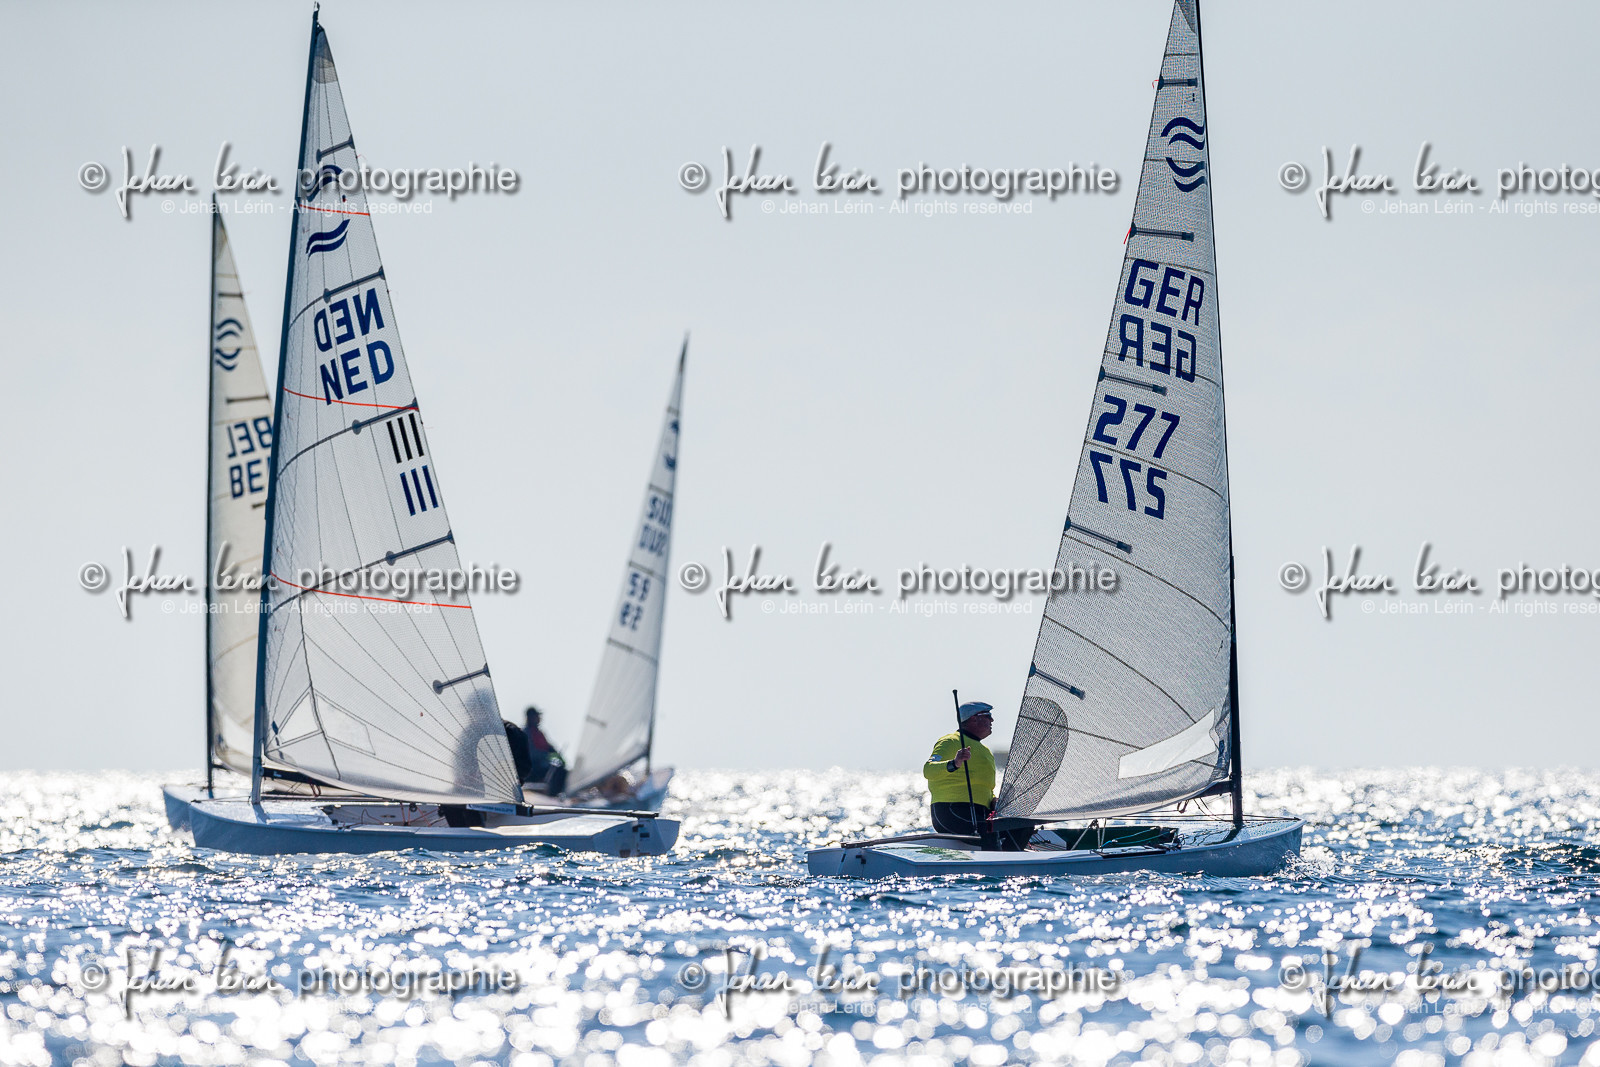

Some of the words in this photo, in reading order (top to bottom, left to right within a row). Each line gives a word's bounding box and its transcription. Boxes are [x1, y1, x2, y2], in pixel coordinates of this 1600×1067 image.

[1125, 258, 1205, 326] GER
[320, 340, 395, 406] NED
[1093, 394, 1181, 459] 277
[229, 456, 271, 499] BE
